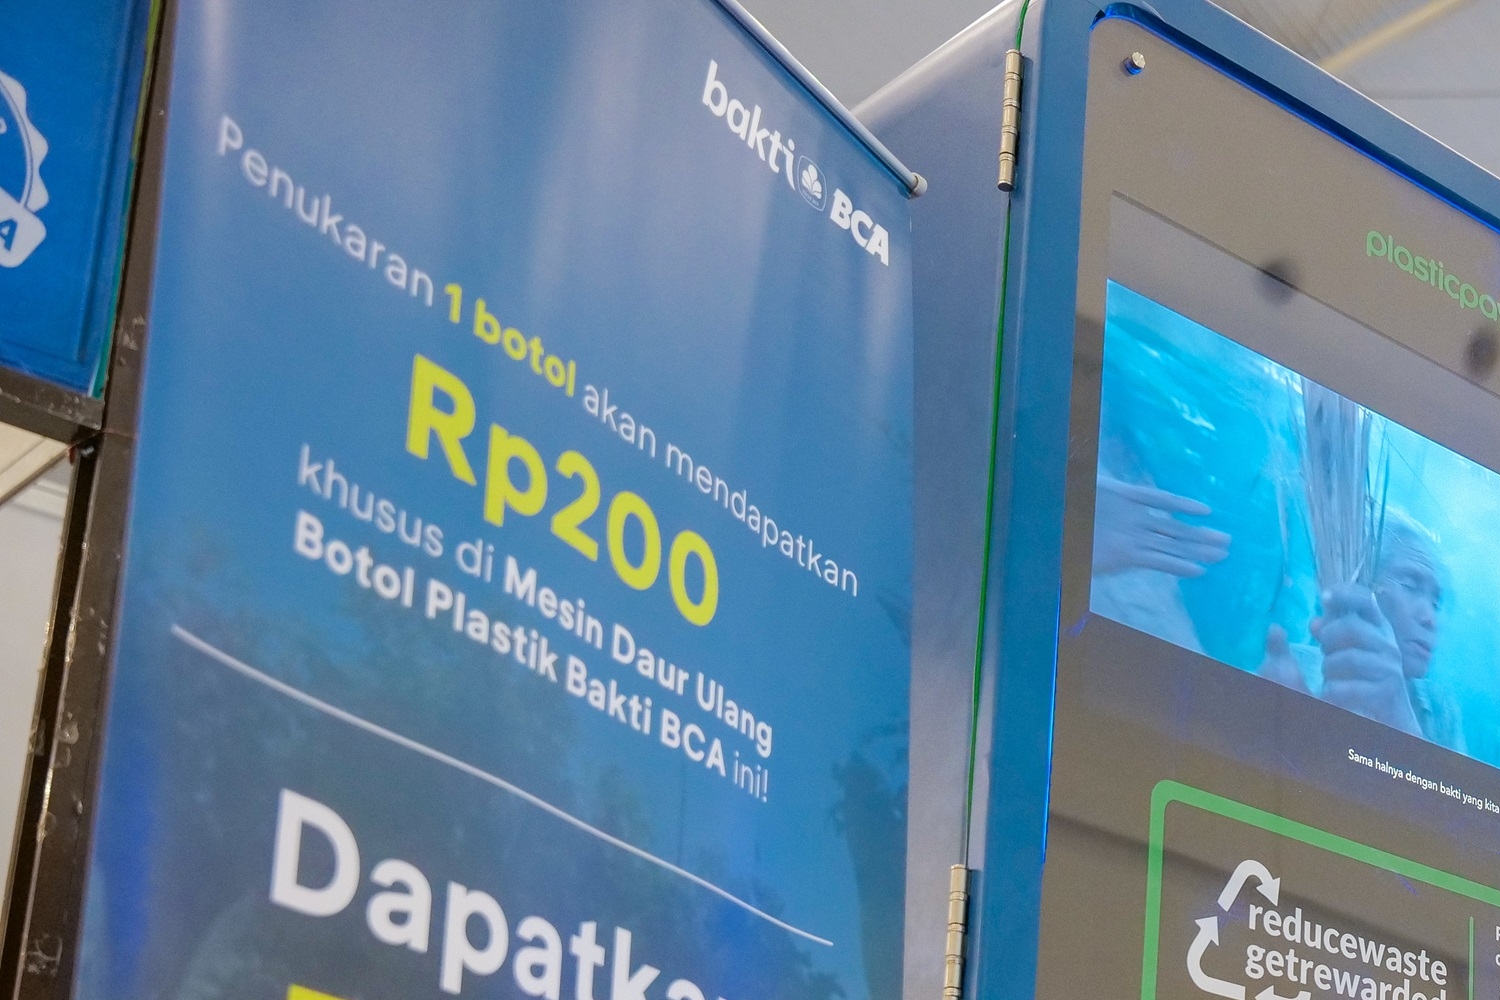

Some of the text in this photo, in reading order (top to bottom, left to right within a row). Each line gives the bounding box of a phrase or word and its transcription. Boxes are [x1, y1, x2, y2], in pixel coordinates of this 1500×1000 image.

[703, 59, 889, 267] bakti BCA
[217, 115, 859, 598] Penukaran 1 botol akan mendapatkan
[406, 353, 720, 627] Rp200
[294, 510, 768, 802] Botol Plastik Bakti BCA ini!
[299, 443, 772, 758] khusus di Mesin Daur Ulang
[1348, 748, 1373, 768] Sama
[1375, 758, 1403, 779] halnya
[1405, 771, 1438, 792] dengan
[1440, 781, 1461, 800] bakti
[1462, 792, 1483, 810] yang
[1485, 798, 1500, 814] kita
[1249, 903, 1448, 985] reducewaste
